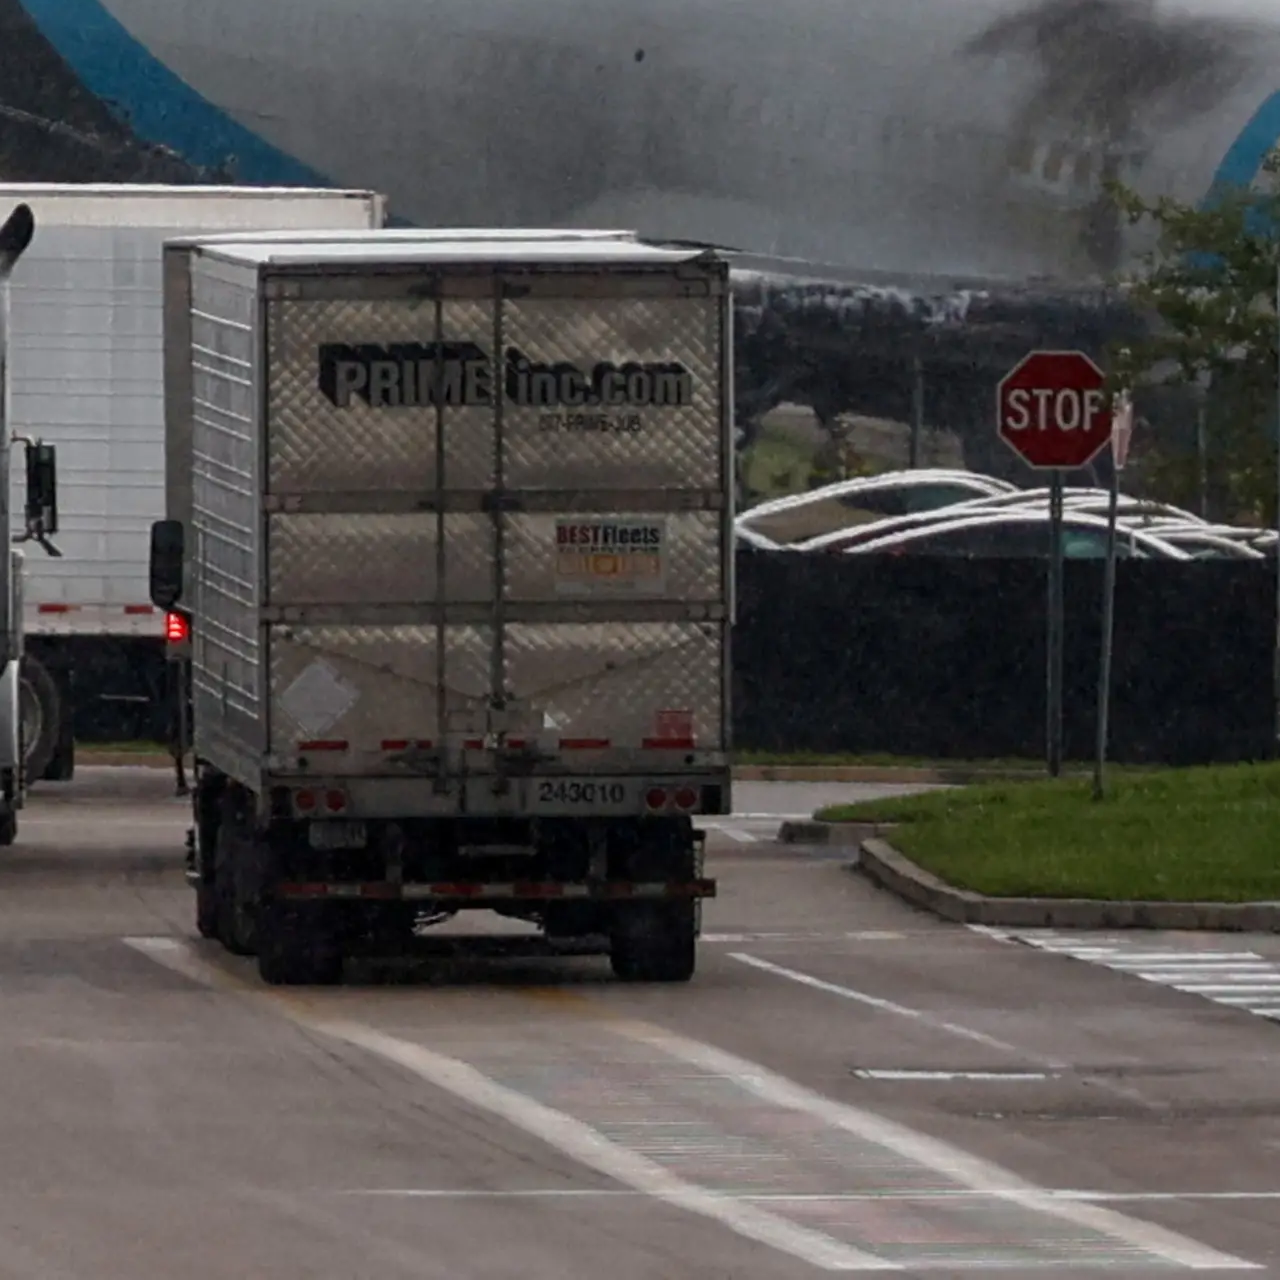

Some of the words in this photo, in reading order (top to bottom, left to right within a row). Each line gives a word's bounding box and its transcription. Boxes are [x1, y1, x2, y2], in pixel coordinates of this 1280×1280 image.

[325, 350, 492, 407] PRIME
[510, 353, 693, 407] inc.com
[1006, 388, 1106, 432] STOP
[539, 781, 625, 804] 243010
